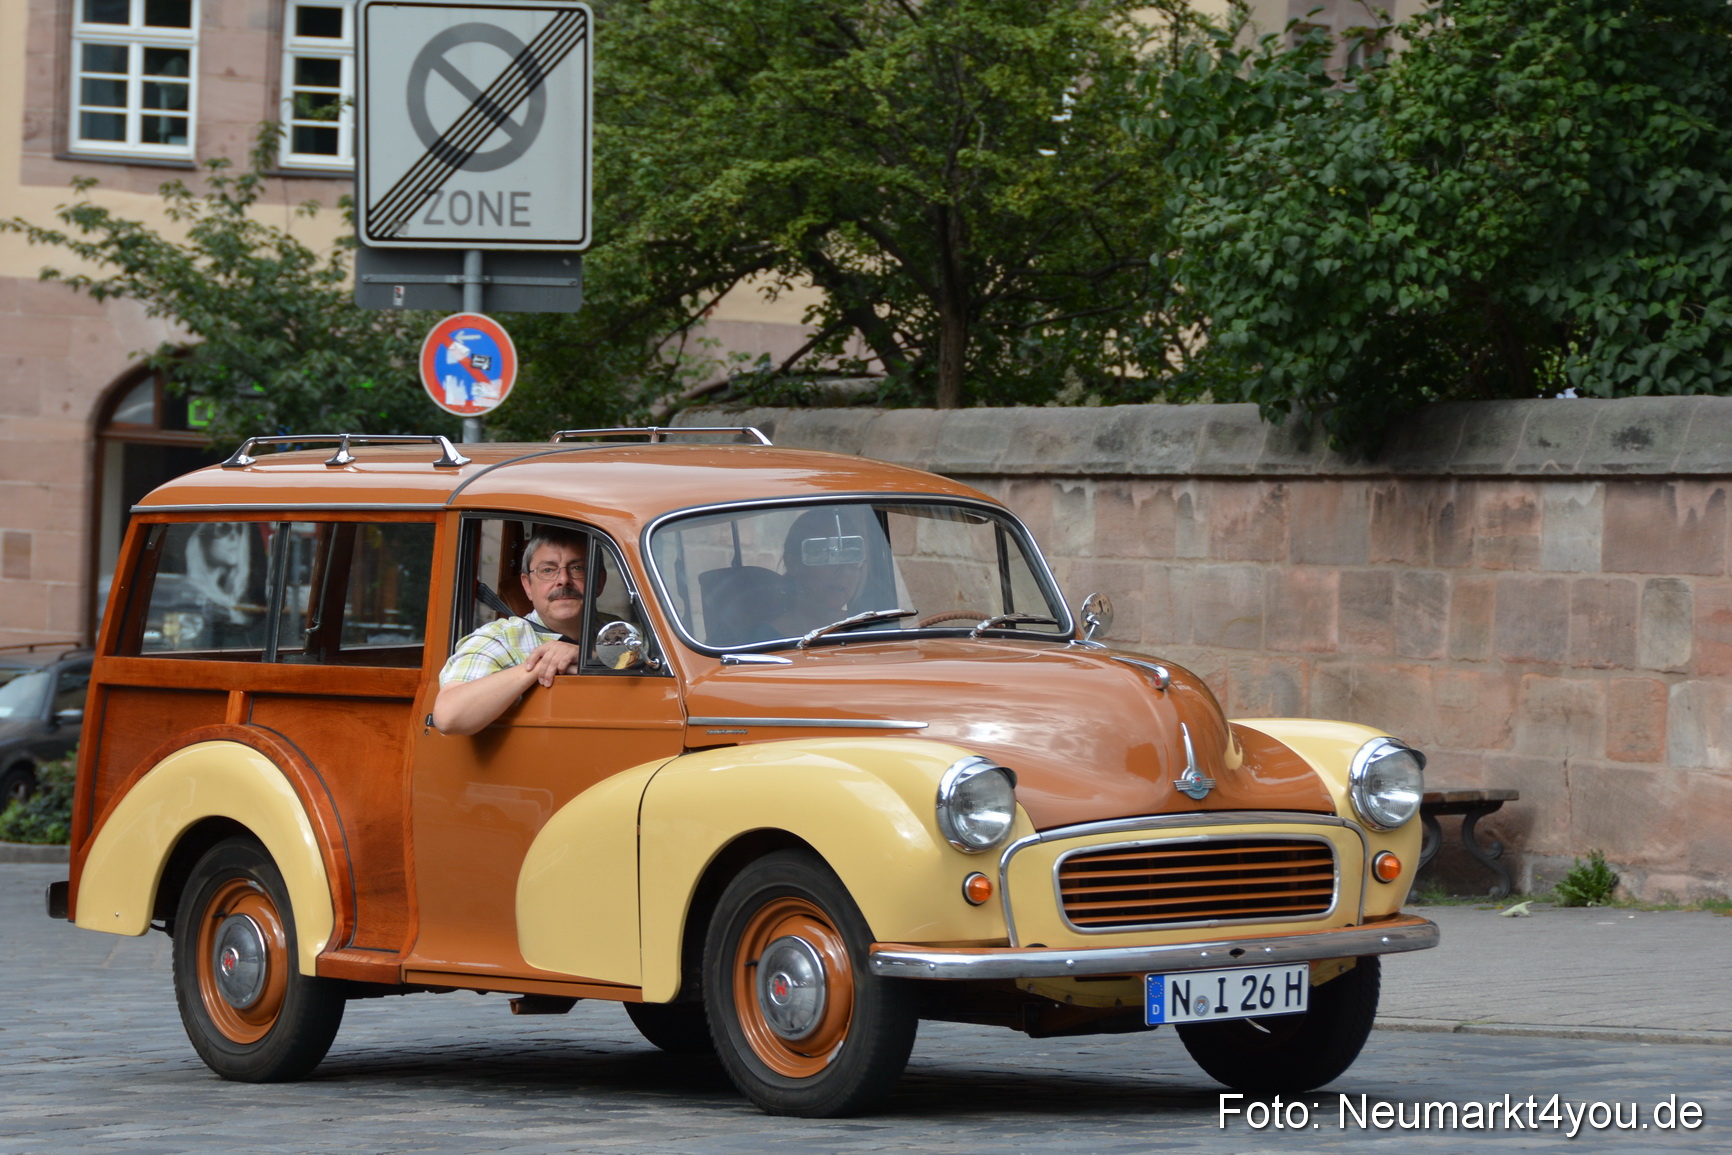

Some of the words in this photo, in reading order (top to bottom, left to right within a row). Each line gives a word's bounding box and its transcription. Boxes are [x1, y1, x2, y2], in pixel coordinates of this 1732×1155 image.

[423, 189, 531, 227] ZONE
[1152, 1004, 1160, 1015] D
[1171, 979, 1191, 1017] N
[1214, 977, 1229, 1014] I
